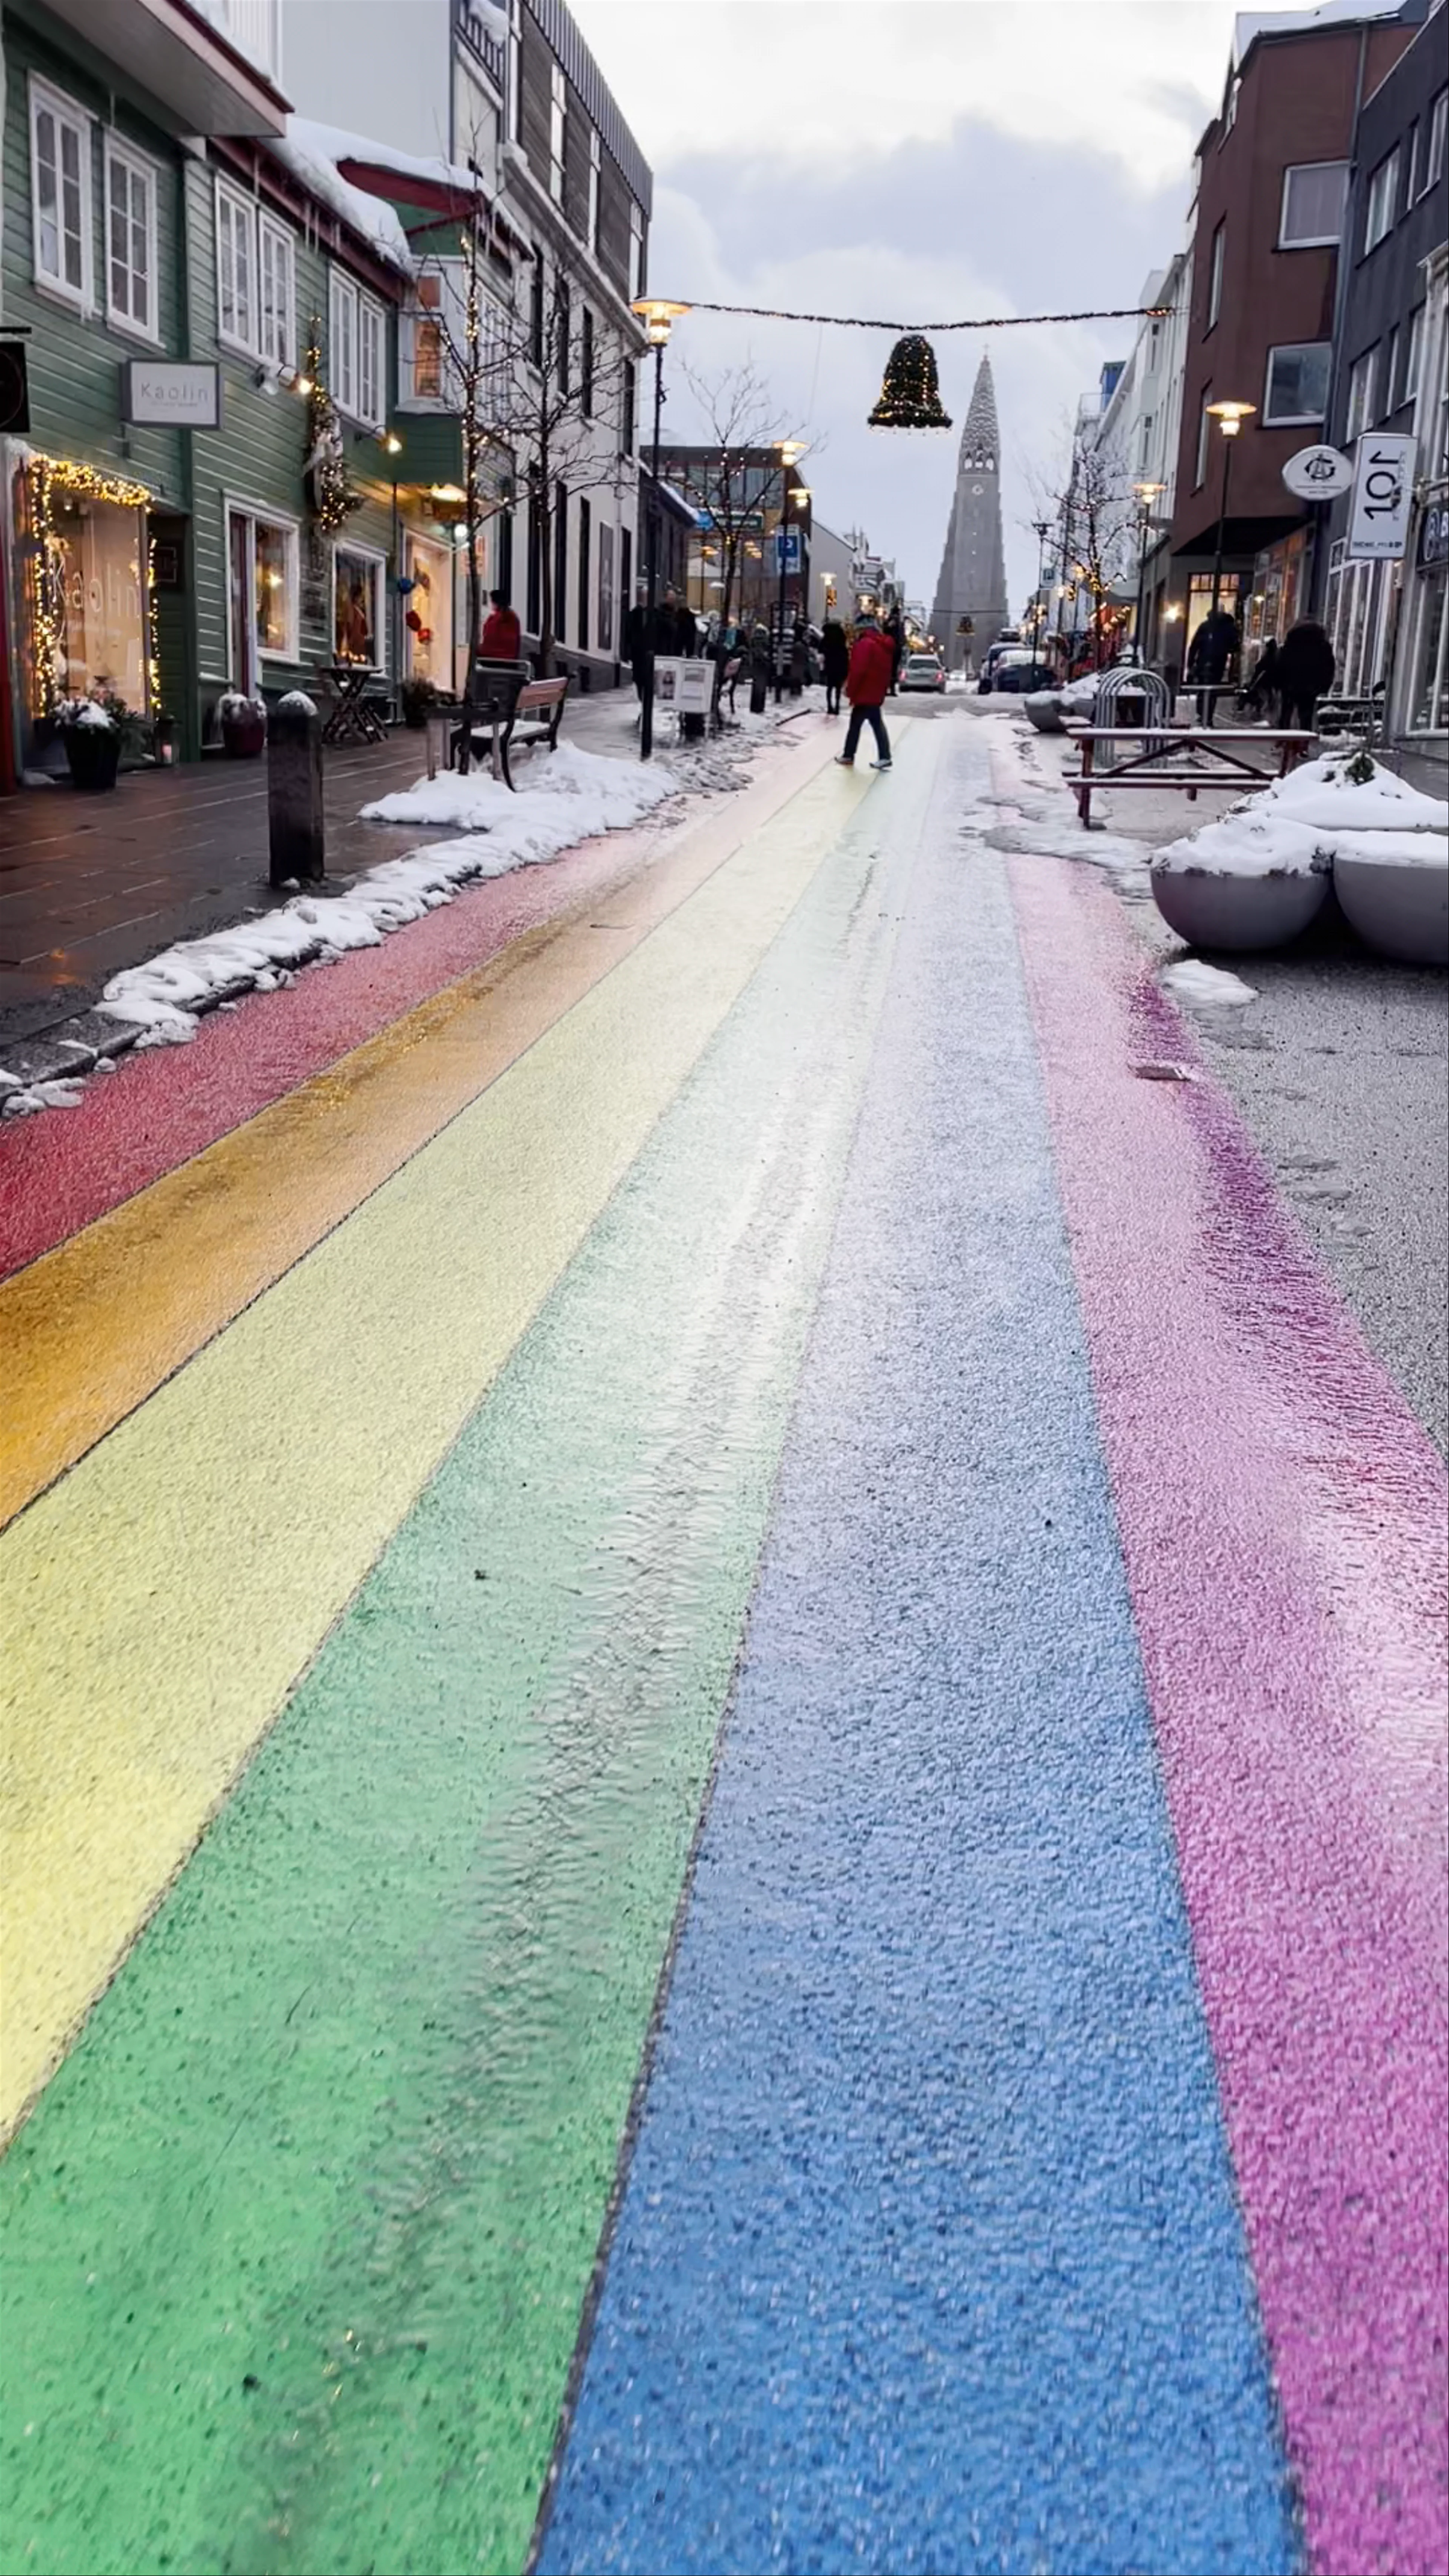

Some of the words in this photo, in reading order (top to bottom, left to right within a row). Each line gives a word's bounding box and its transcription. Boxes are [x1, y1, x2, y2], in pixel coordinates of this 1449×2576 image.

[141, 382, 208, 401] Kaolin
[1363, 450, 1399, 520] 101
[52, 552, 137, 617] Kaolin
